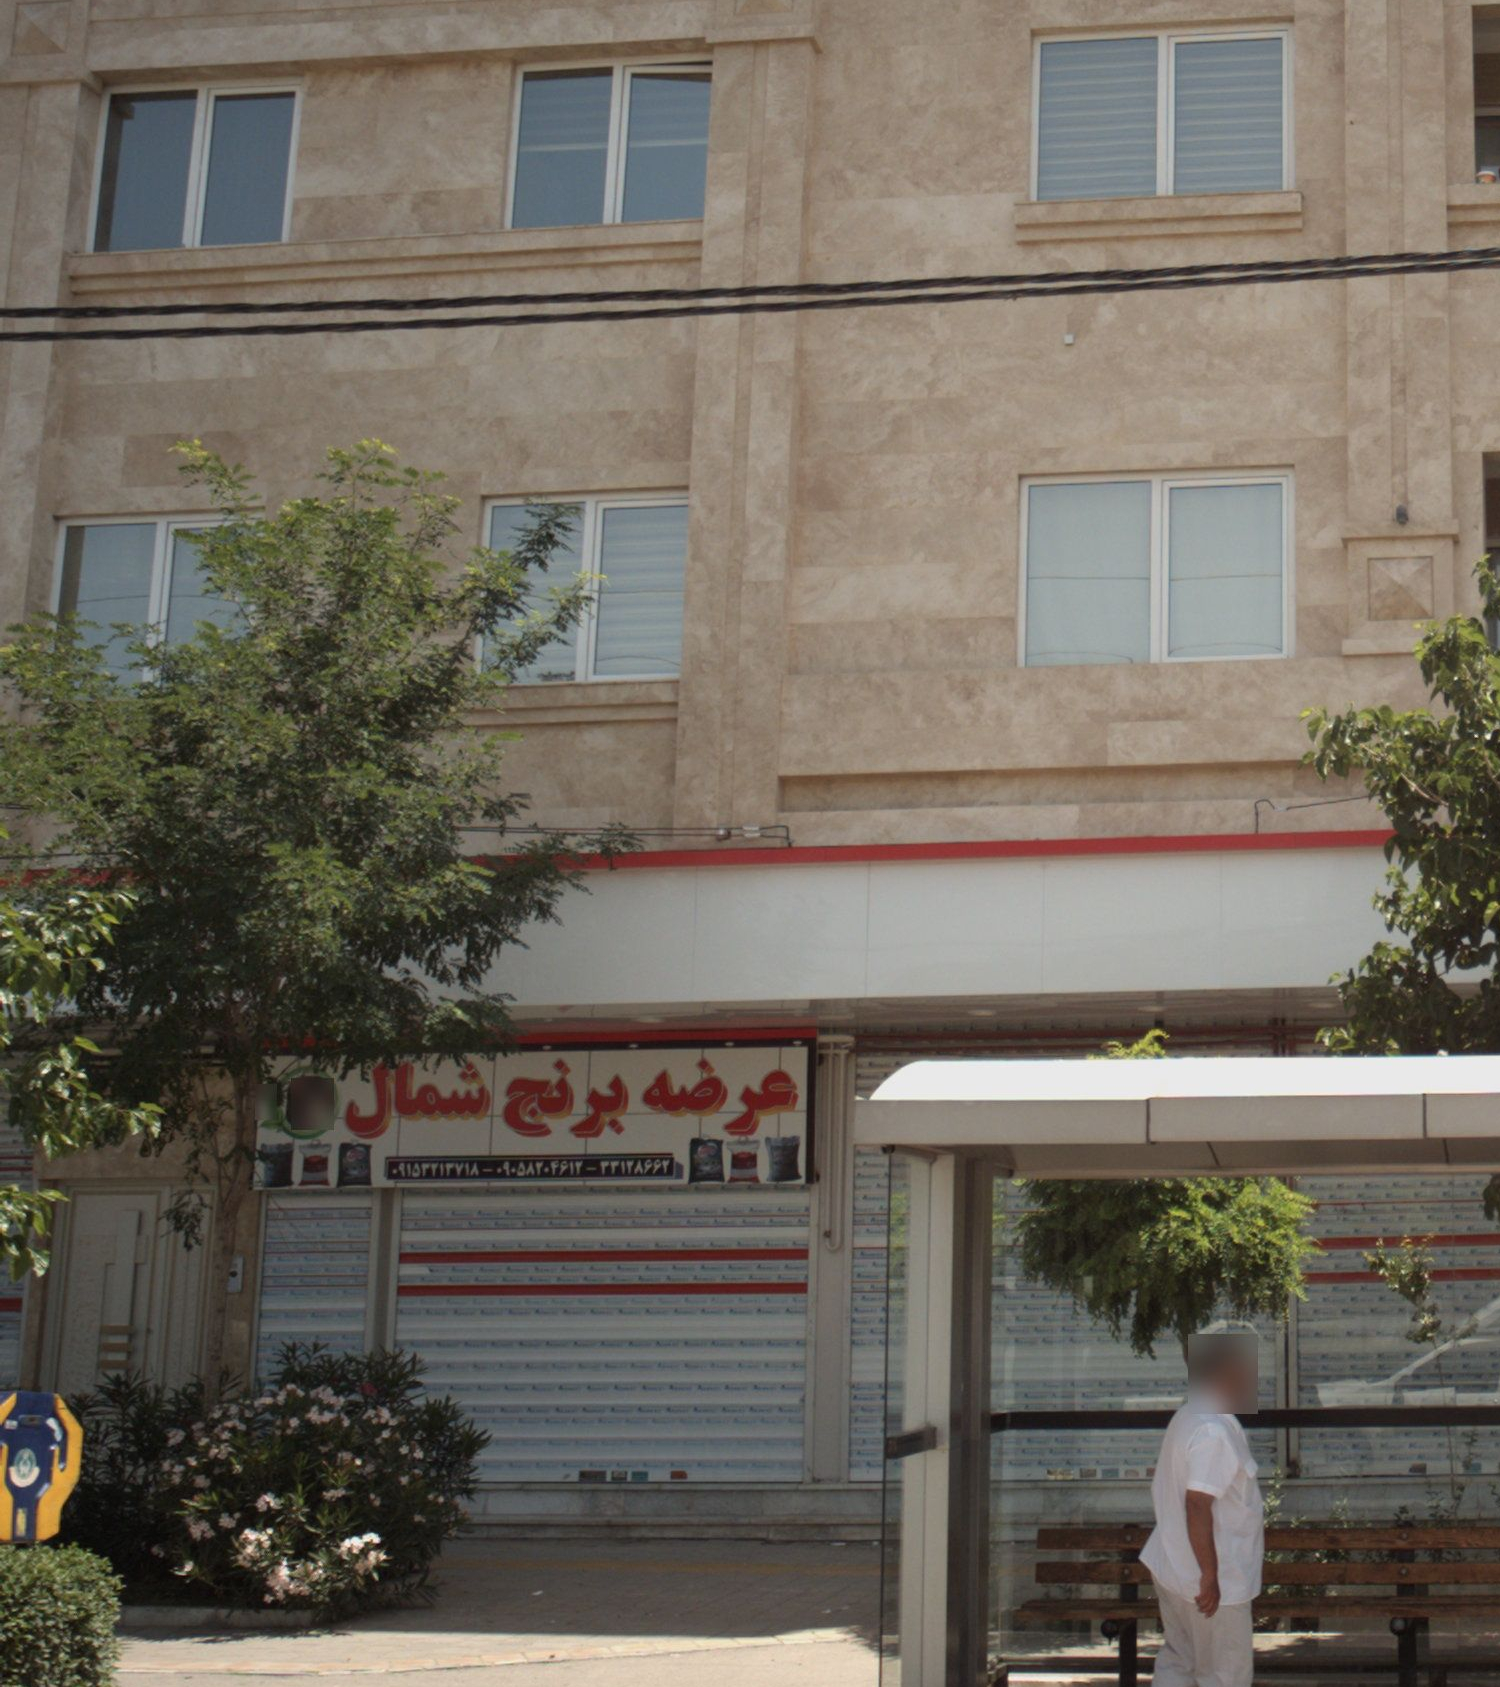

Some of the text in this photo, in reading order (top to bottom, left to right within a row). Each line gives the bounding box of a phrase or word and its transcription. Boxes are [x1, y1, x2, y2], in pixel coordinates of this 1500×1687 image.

[344, 1057, 799, 1139] عرضه برنج شمال
